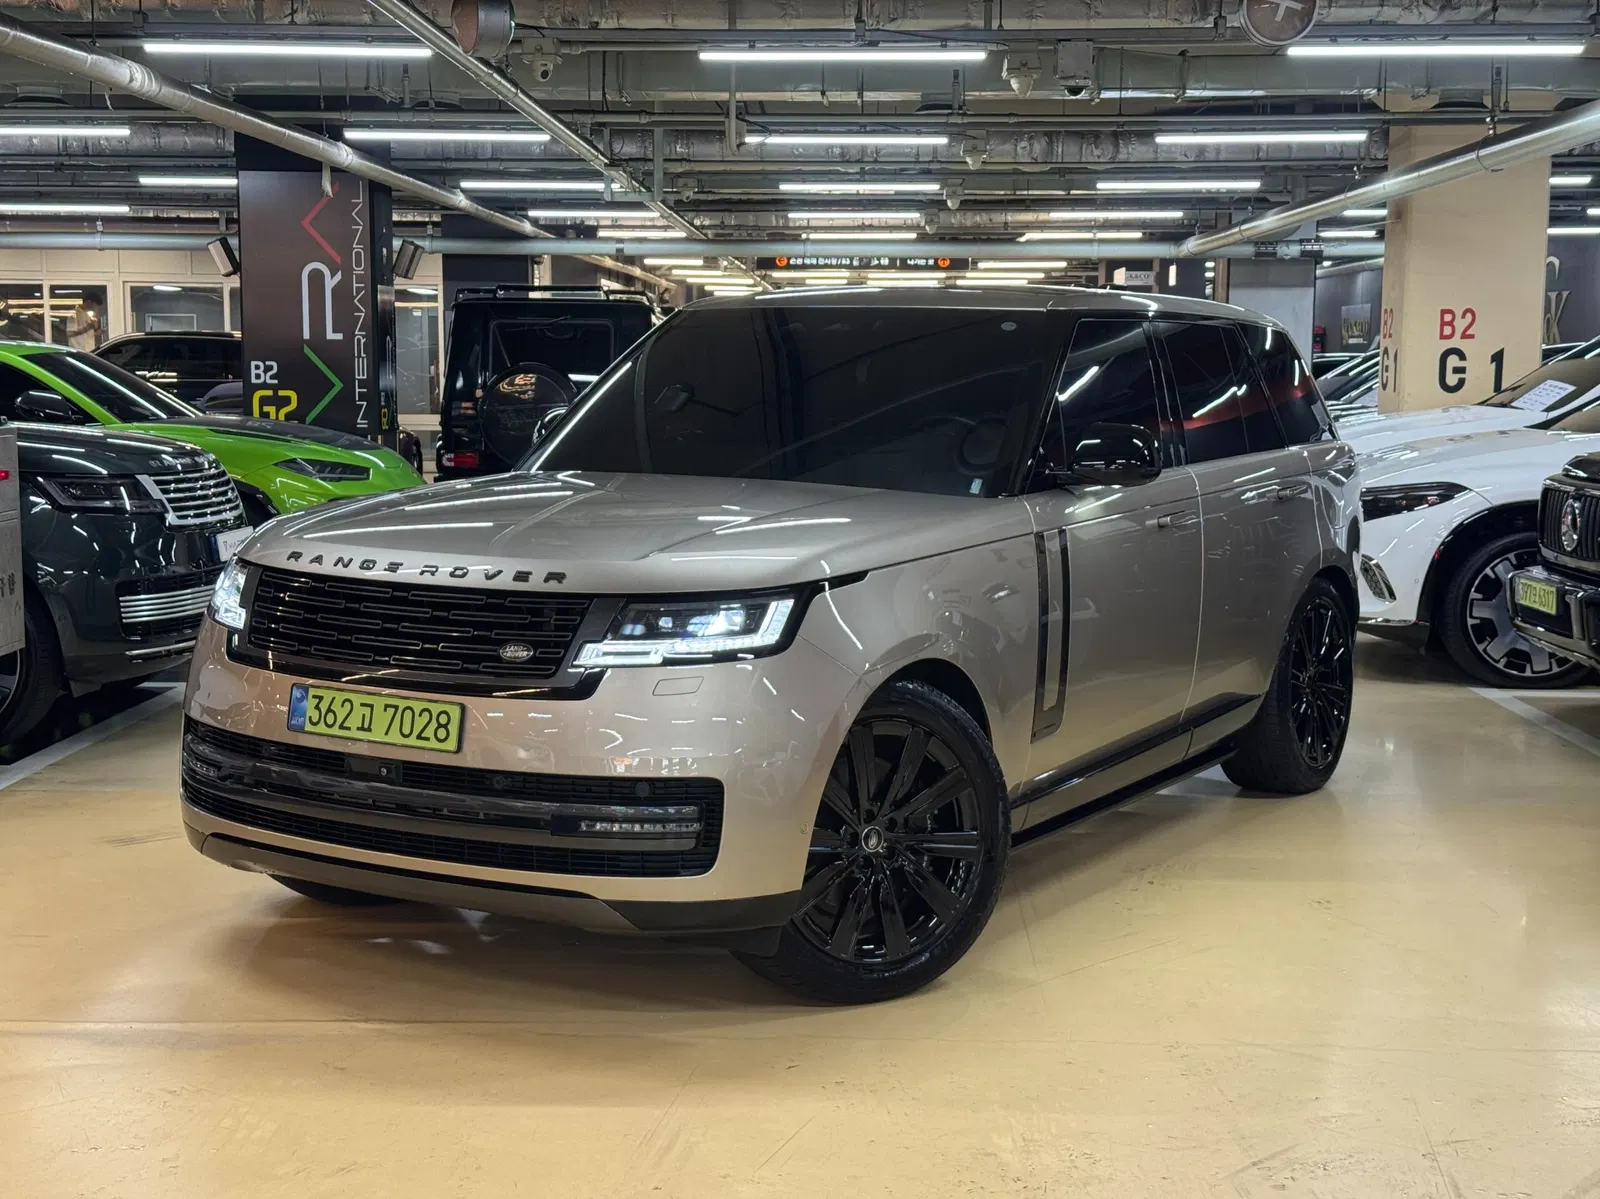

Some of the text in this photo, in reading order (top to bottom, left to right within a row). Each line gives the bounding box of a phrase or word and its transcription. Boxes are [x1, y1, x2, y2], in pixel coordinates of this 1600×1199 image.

[351, 180, 369, 428] INTERNATIONAL
[1382, 307, 1394, 340] B2
[1439, 307, 1477, 340] B2
[250, 360, 278, 384] B2
[252, 389, 298, 424] G2
[286, 550, 568, 585] RANGE ROVER
[308, 694, 452, 744] 362고 7028
